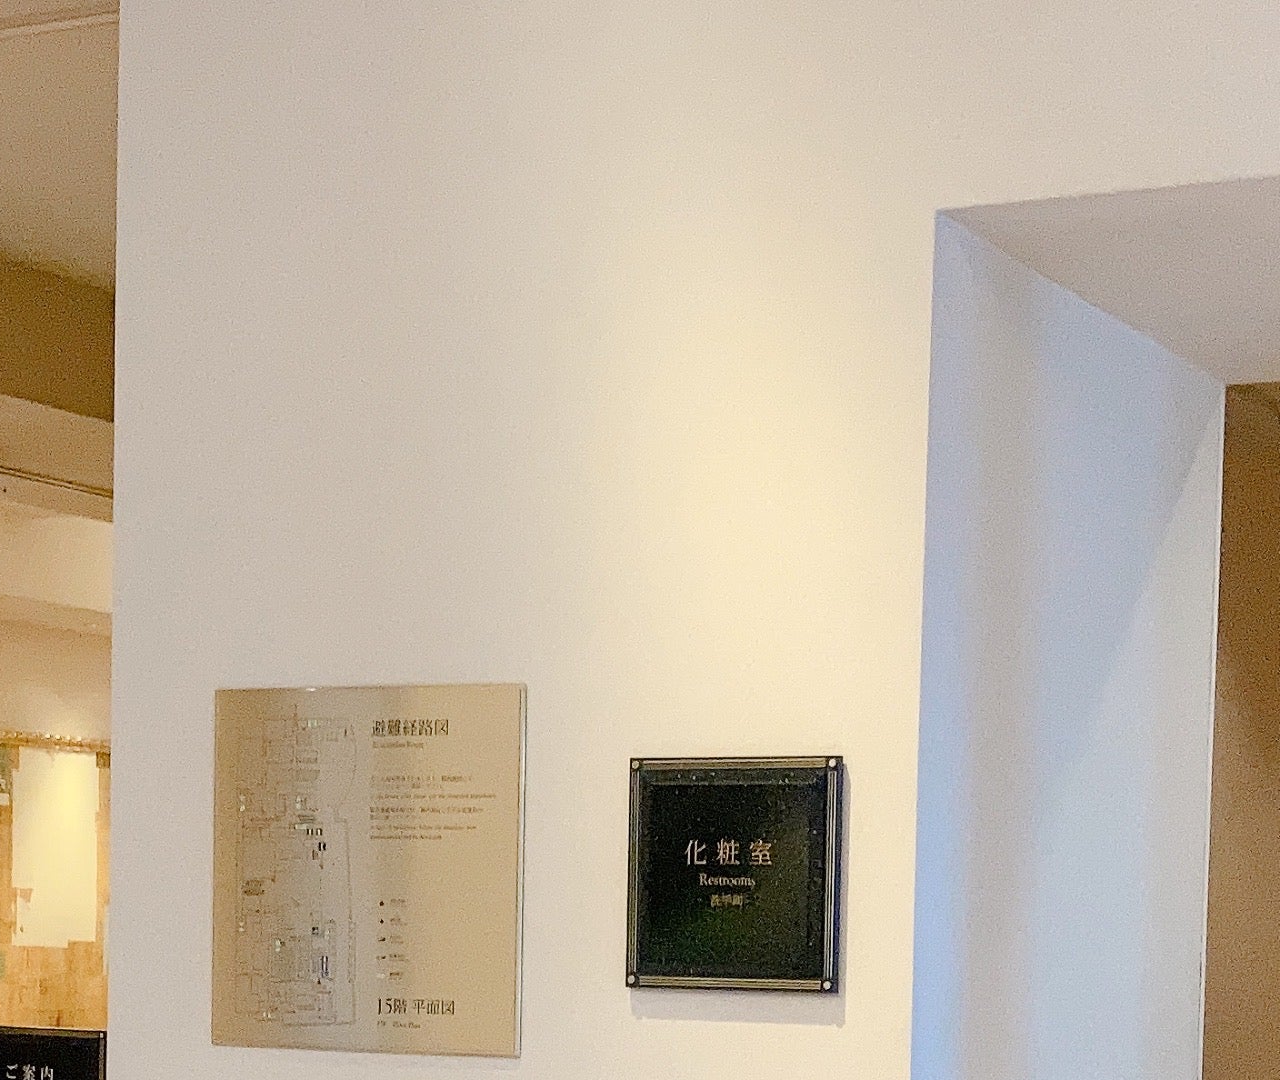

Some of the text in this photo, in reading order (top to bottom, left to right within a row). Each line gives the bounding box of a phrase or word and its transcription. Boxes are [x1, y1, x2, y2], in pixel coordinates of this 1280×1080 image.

[684, 838, 773, 867] 化粧室
[699, 873, 756, 889] Restrooms
